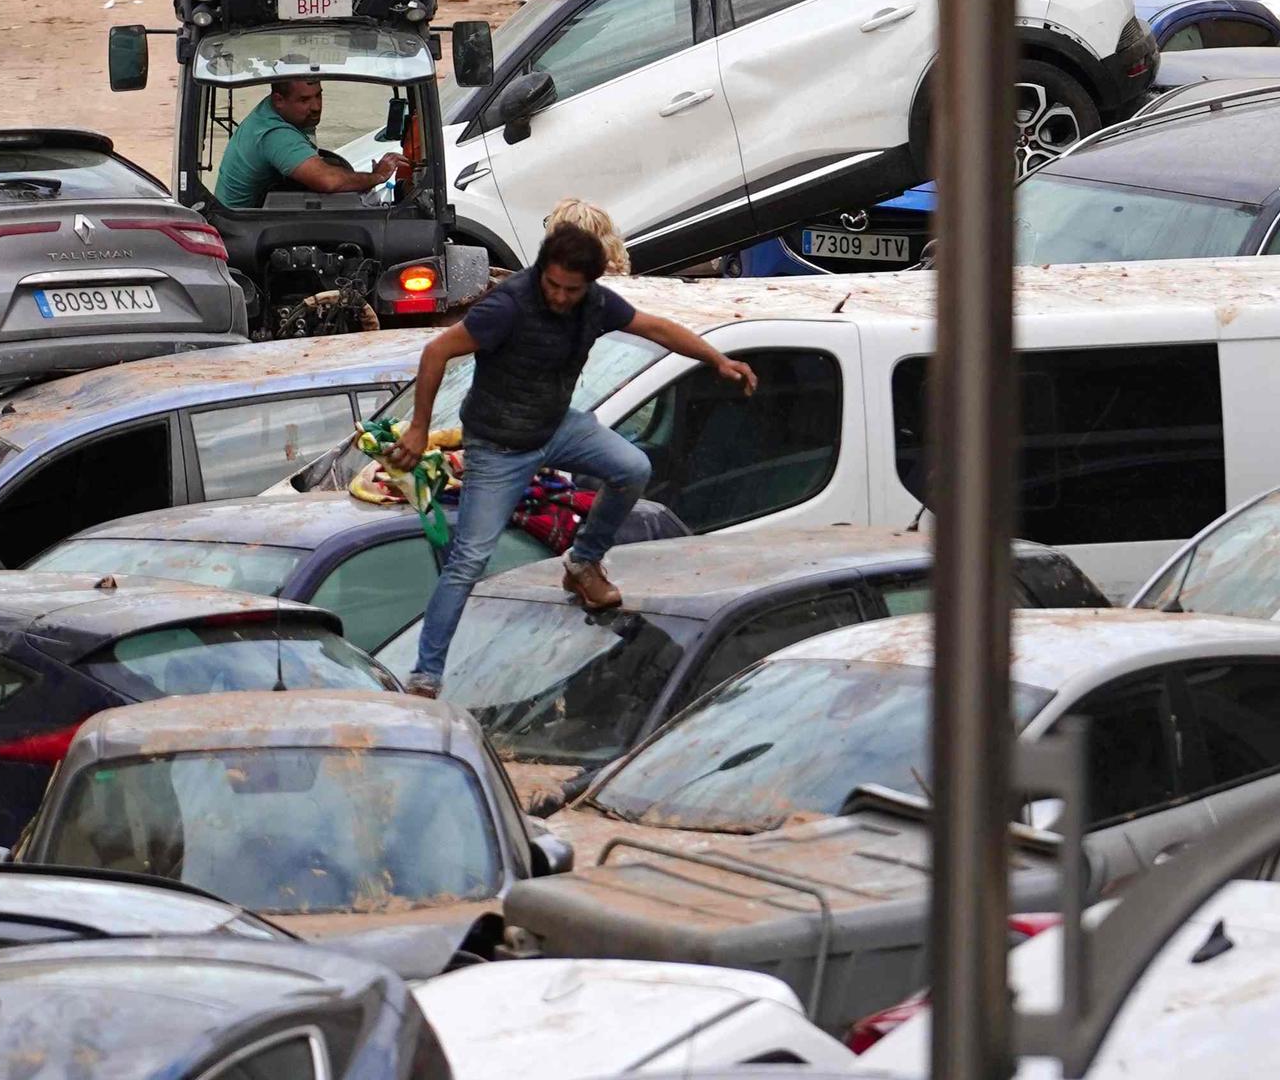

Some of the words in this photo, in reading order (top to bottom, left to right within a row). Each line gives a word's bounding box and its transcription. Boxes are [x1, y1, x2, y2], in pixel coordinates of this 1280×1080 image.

[48, 249, 135, 262] TALISMAN
[816, 234, 862, 255] 7309
[869, 238, 905, 258] JTV
[52, 290, 108, 313] 8099
[111, 289, 154, 310] KXJ
